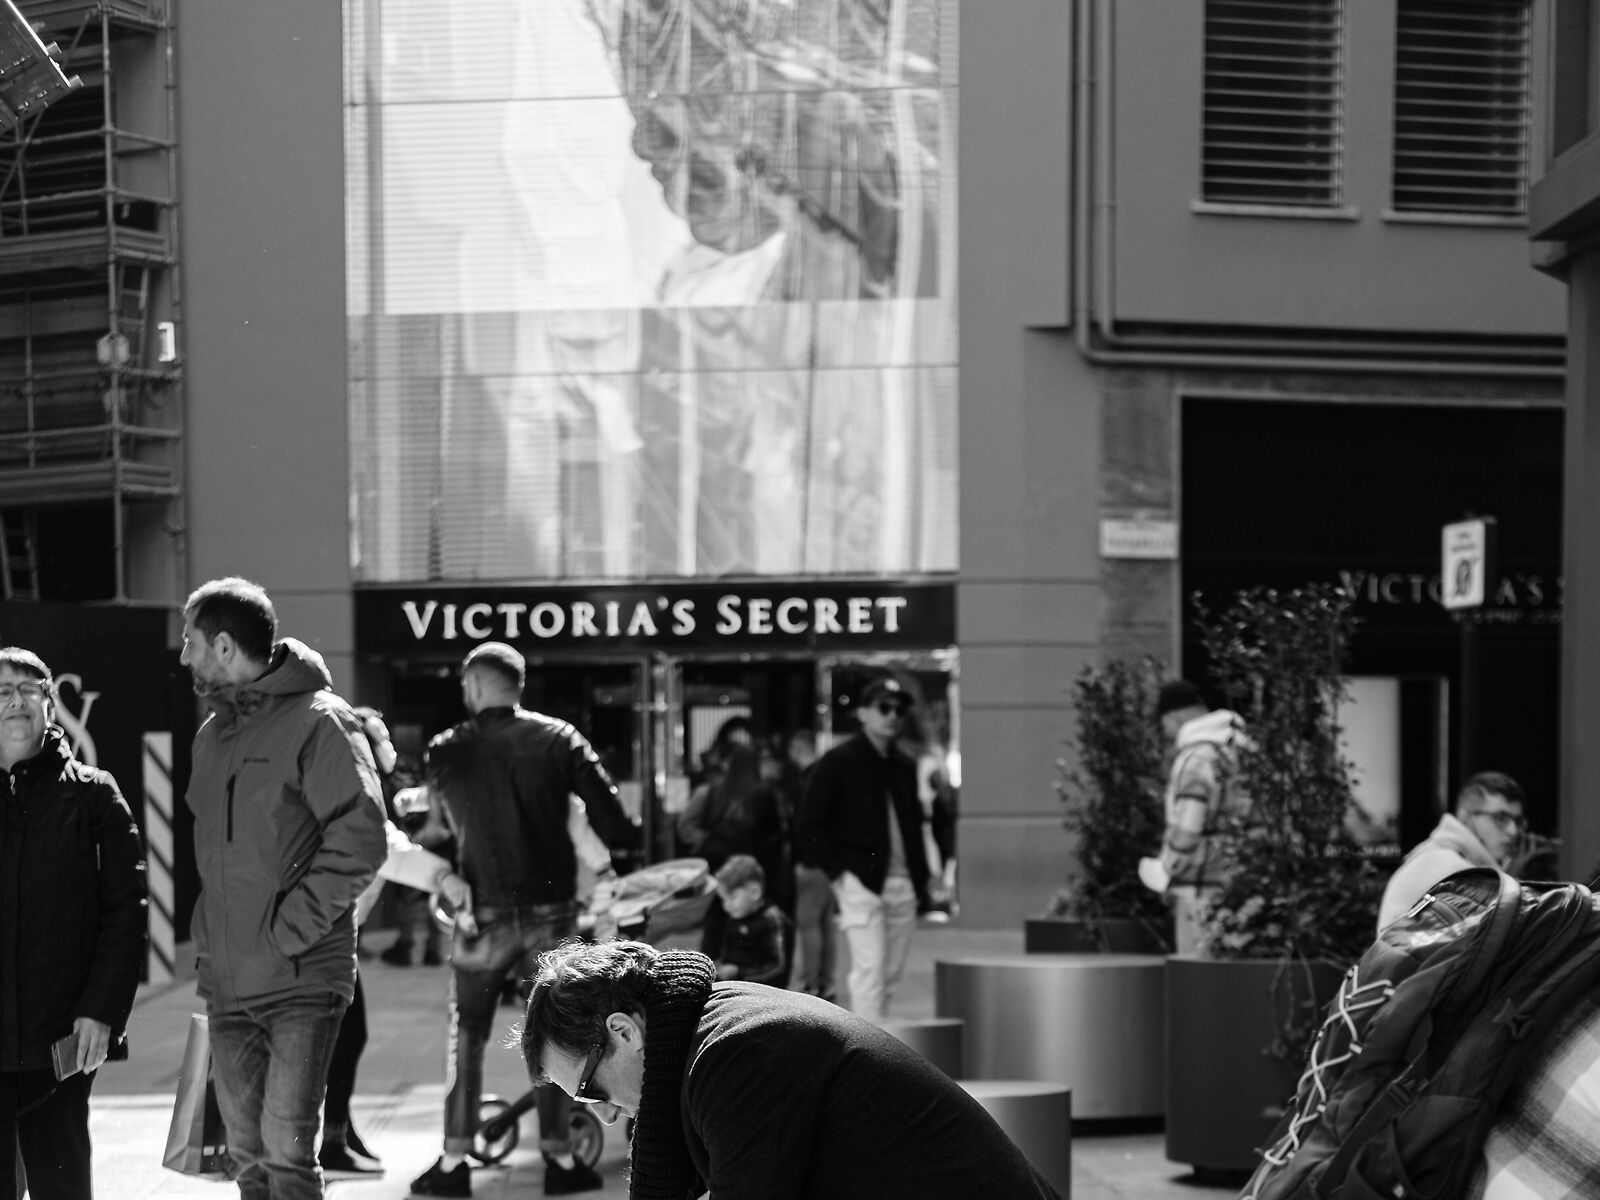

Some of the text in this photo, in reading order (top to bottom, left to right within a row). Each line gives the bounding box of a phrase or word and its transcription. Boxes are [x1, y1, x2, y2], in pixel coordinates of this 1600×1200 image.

[1339, 569, 1544, 606] VICTA'S
[402, 595, 908, 639] VICTORIA'S SECRET
